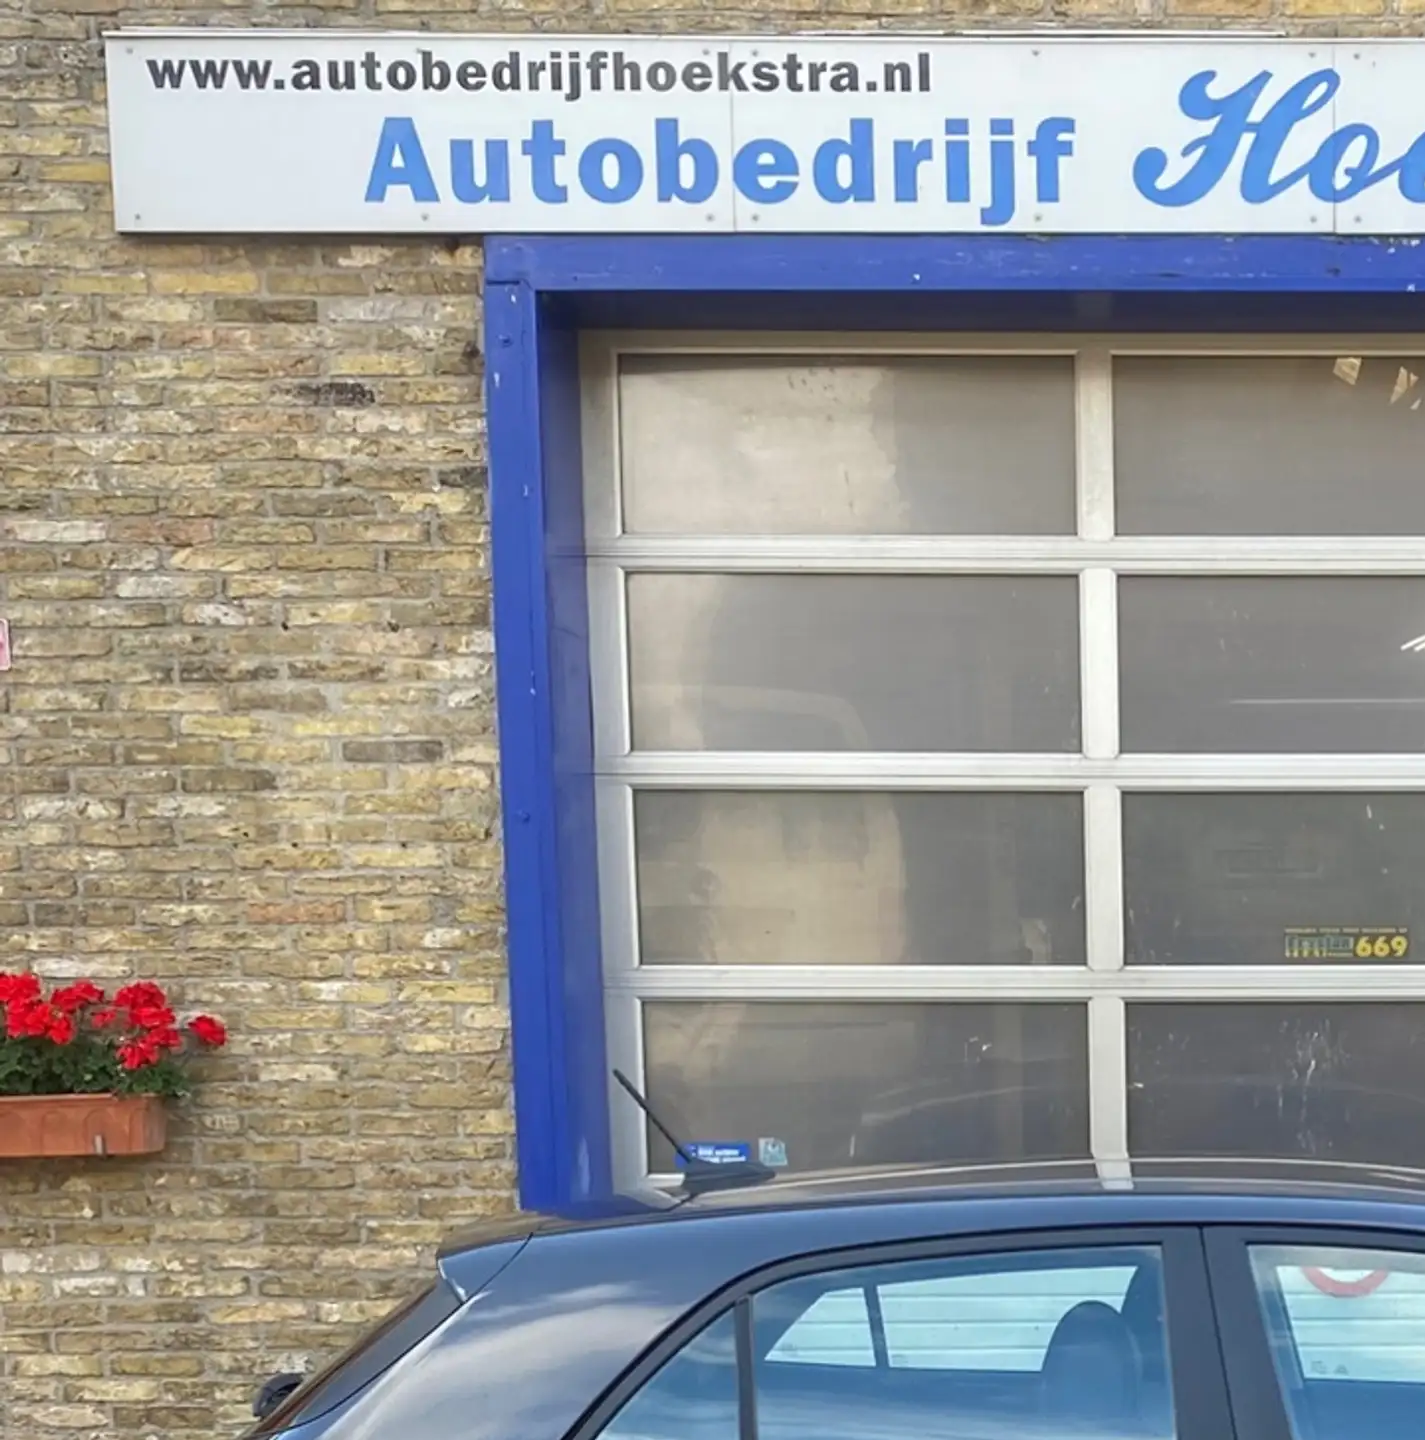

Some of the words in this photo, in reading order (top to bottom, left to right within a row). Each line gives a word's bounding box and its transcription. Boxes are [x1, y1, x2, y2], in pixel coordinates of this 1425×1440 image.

[147, 51, 932, 101] www.autobedrijfhoekstra.nl
[364, 116, 1076, 224] Autobedrijf
[1356, 936, 1408, 957] 669
